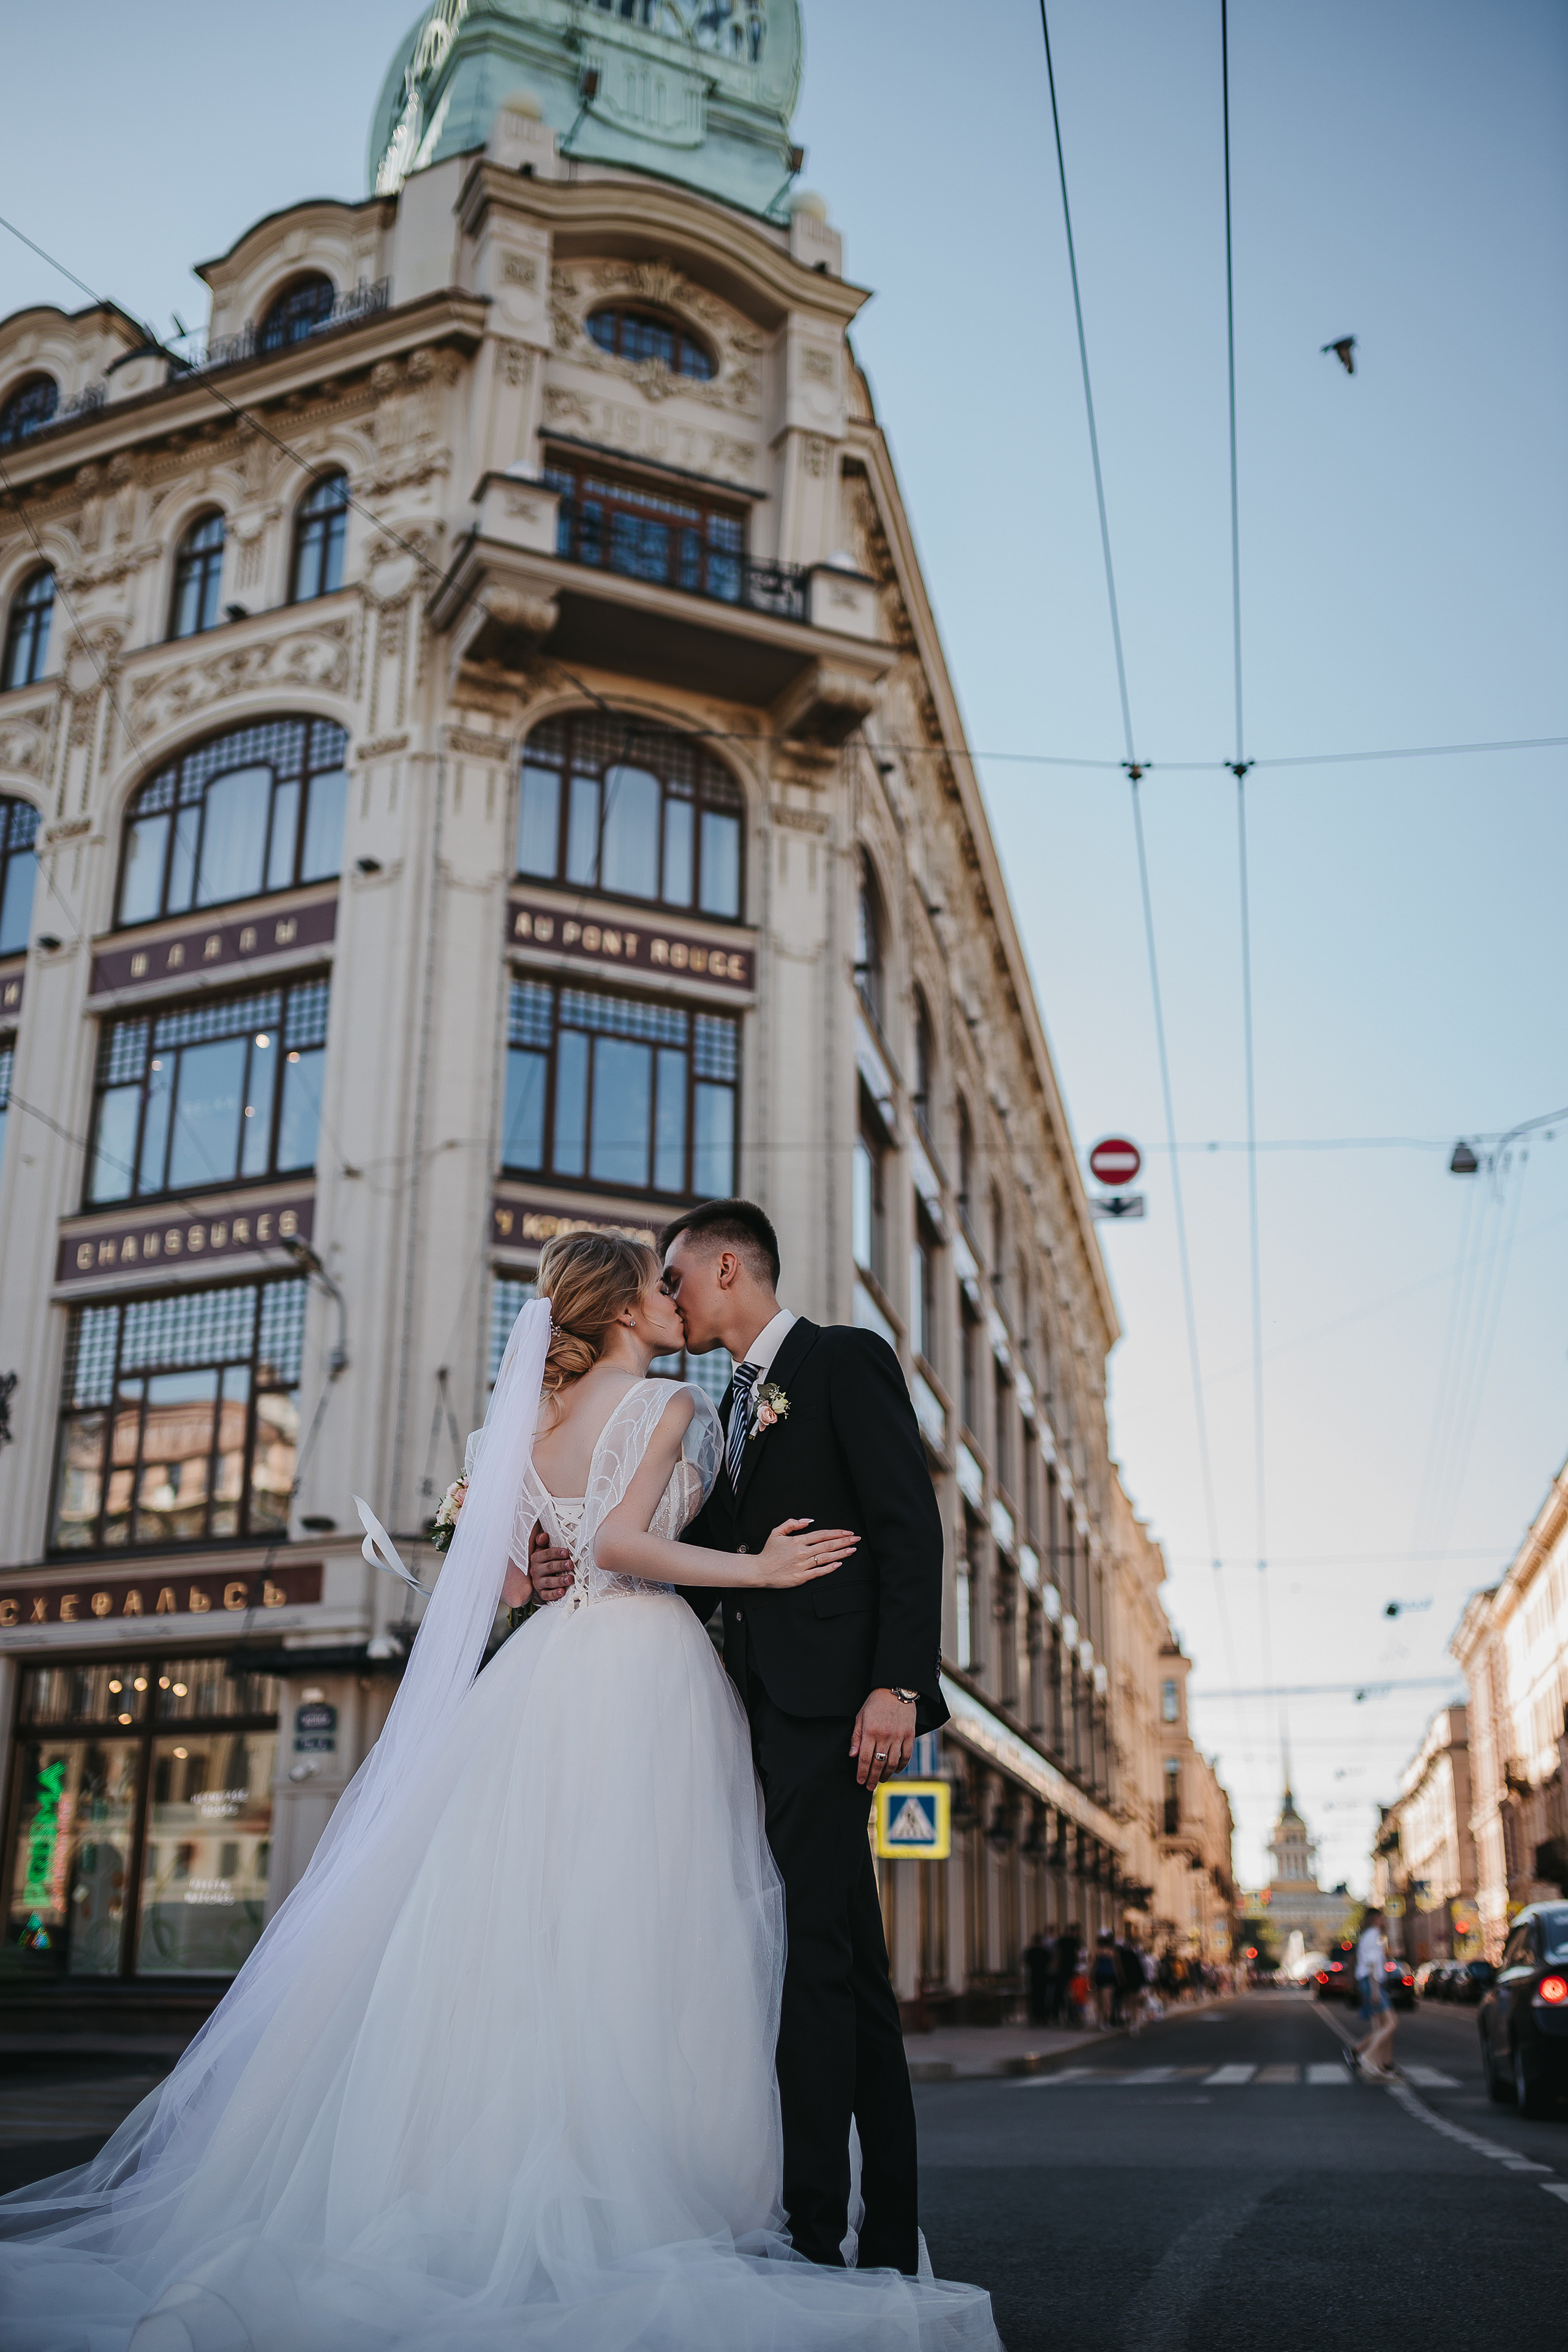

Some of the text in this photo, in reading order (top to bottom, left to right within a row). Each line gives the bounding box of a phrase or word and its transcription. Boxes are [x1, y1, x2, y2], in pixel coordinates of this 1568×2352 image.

[602, 405, 696, 458] 1907
[514, 911, 747, 980] AU PONT ROUGE
[77, 1210, 298, 1270] CHAUSSURES
